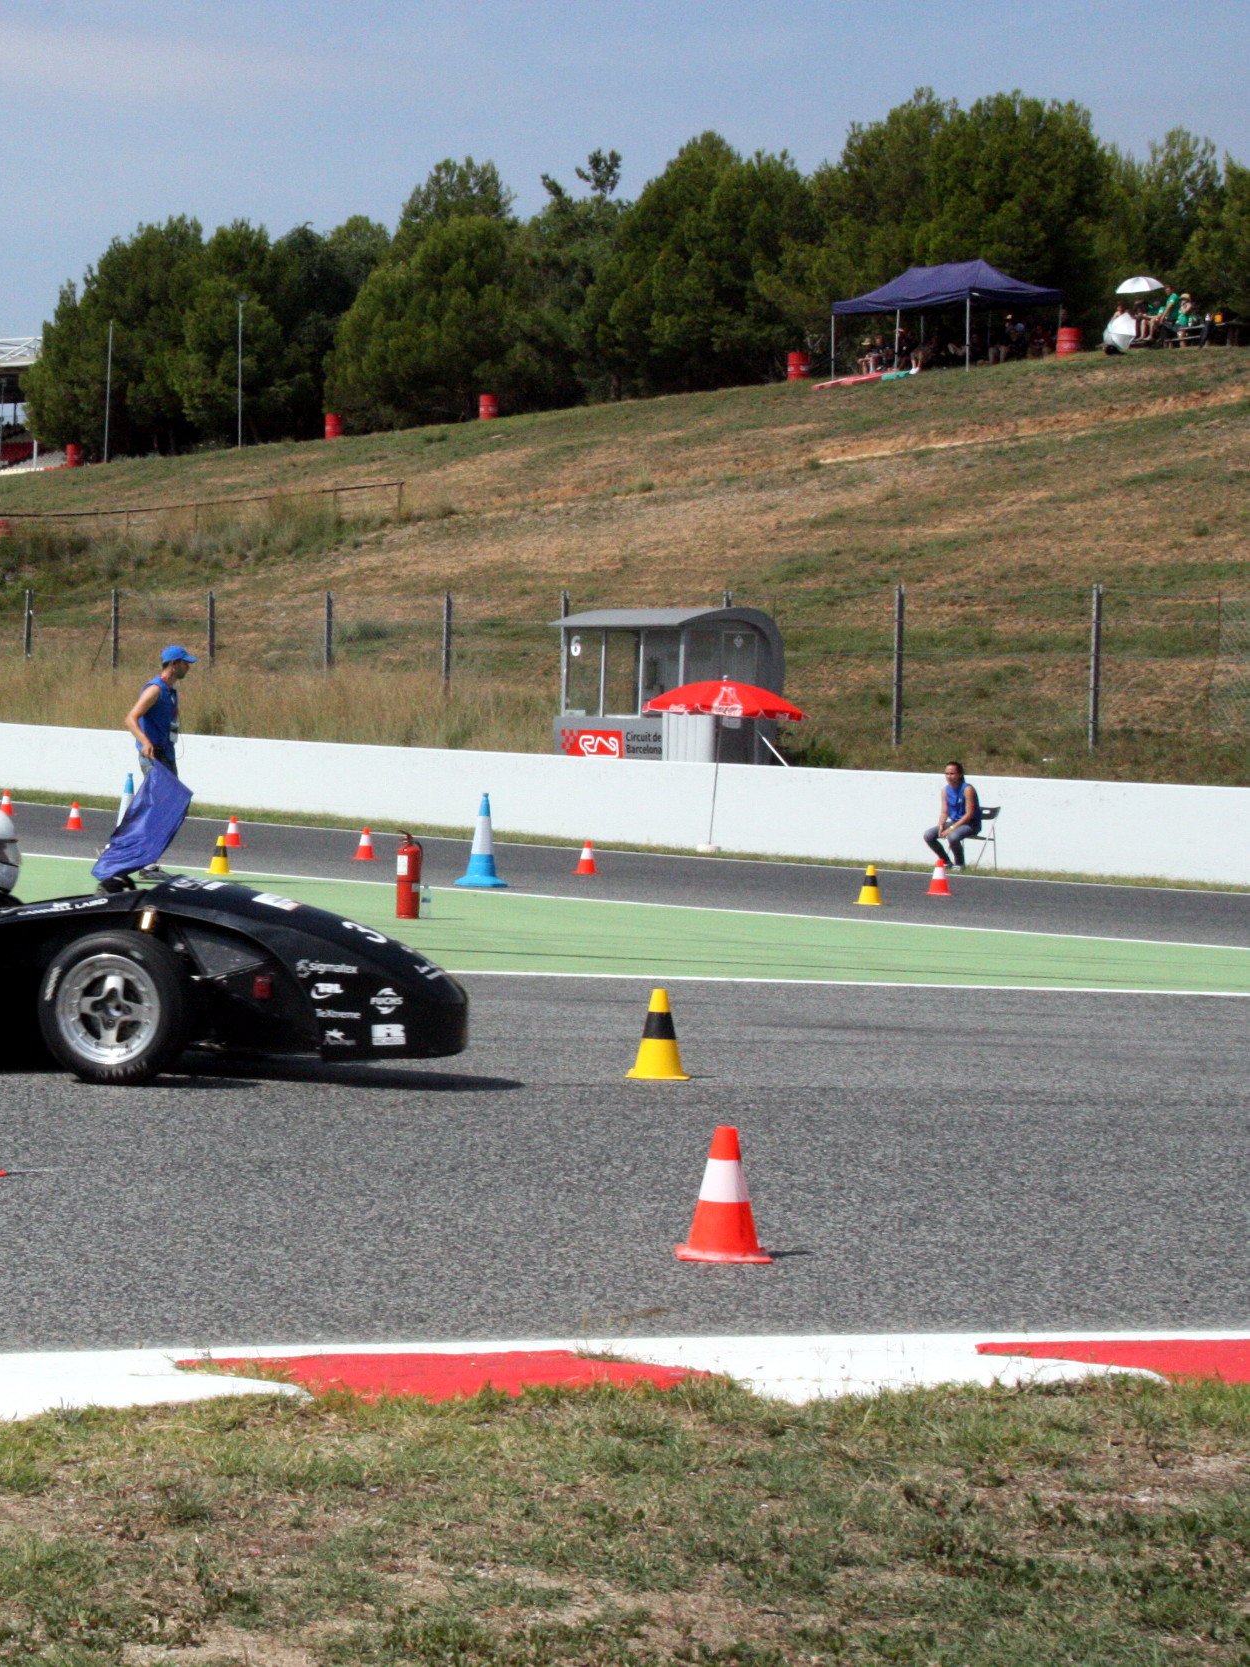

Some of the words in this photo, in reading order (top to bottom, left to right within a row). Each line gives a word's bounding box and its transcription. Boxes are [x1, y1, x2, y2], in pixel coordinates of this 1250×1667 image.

[571, 635, 581, 656] 6
[626, 731, 651, 742] Circuit
[652, 731, 662, 742] de
[626, 744, 662, 754] Barcelona
